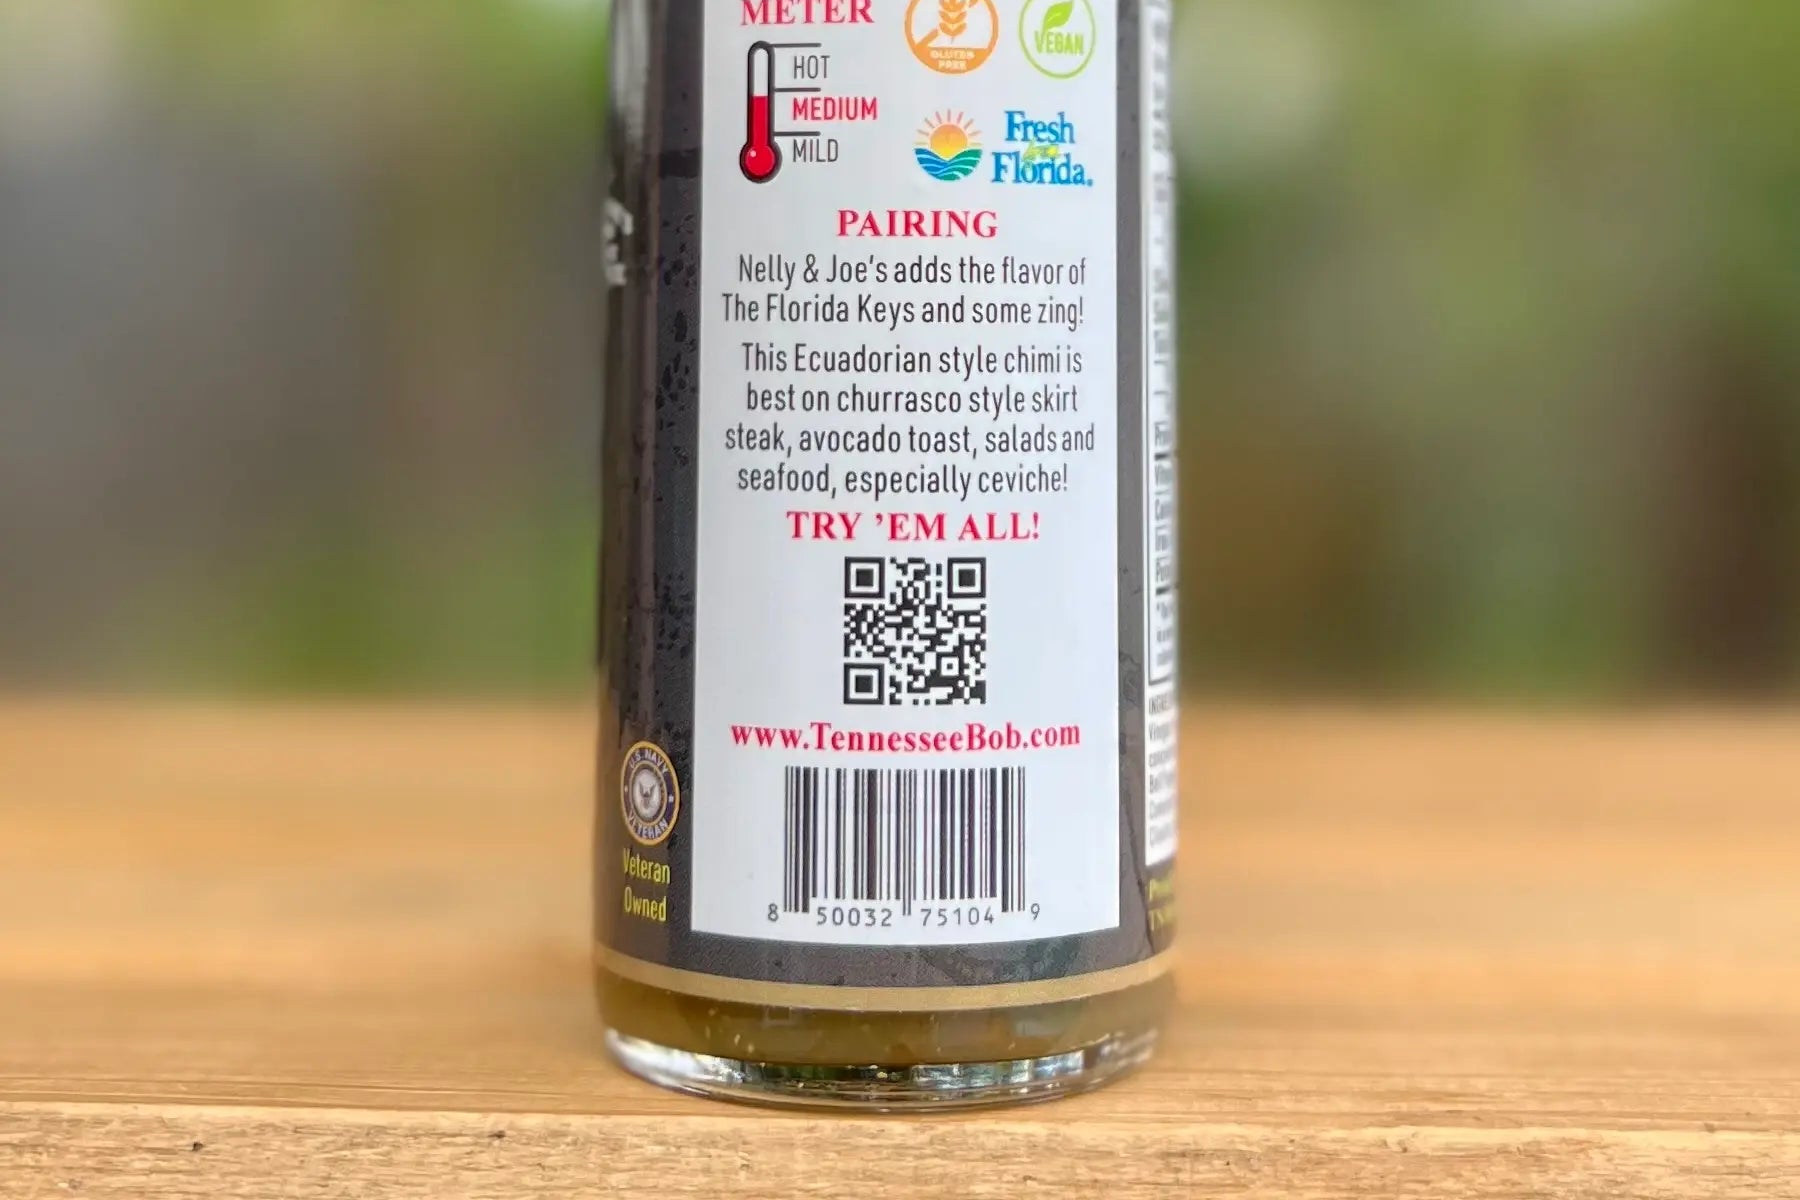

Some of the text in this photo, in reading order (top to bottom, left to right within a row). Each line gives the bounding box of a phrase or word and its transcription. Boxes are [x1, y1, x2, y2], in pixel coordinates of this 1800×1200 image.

[1034, 30, 1084, 55] VEGAN
[794, 55, 830, 79] HOT
[793, 97, 877, 120] MEDIUM
[1005, 111, 1075, 143] Fresh
[793, 139, 838, 162] MILD
[991, 151, 1093, 186] Florida.
[838, 210, 996, 237] PAIRING
[739, 254, 1085, 291] Nelly & Joe's adds the flavor of
[722, 293, 1083, 332] The Florida Keys and some zing!
[742, 342, 1082, 381] This Ecuadorian style chimi is
[747, 382, 1077, 421] best on churrasco style skirt
[725, 422, 1094, 459] steak, avocado toast, salads and
[738, 462, 1067, 501] seafood, especially ceviche!
[787, 511, 860, 539] TRY
[959, 512, 1038, 540] ALL!
[731, 722, 1079, 752] www.TennesseeBob.com
[644, 748, 669, 774] NAVY
[628, 812, 668, 839] VETERAN
[623, 848, 670, 884] Veteran
[624, 886, 666, 921] Owned
[768, 903, 1040, 927] 8 50032 75104 9
